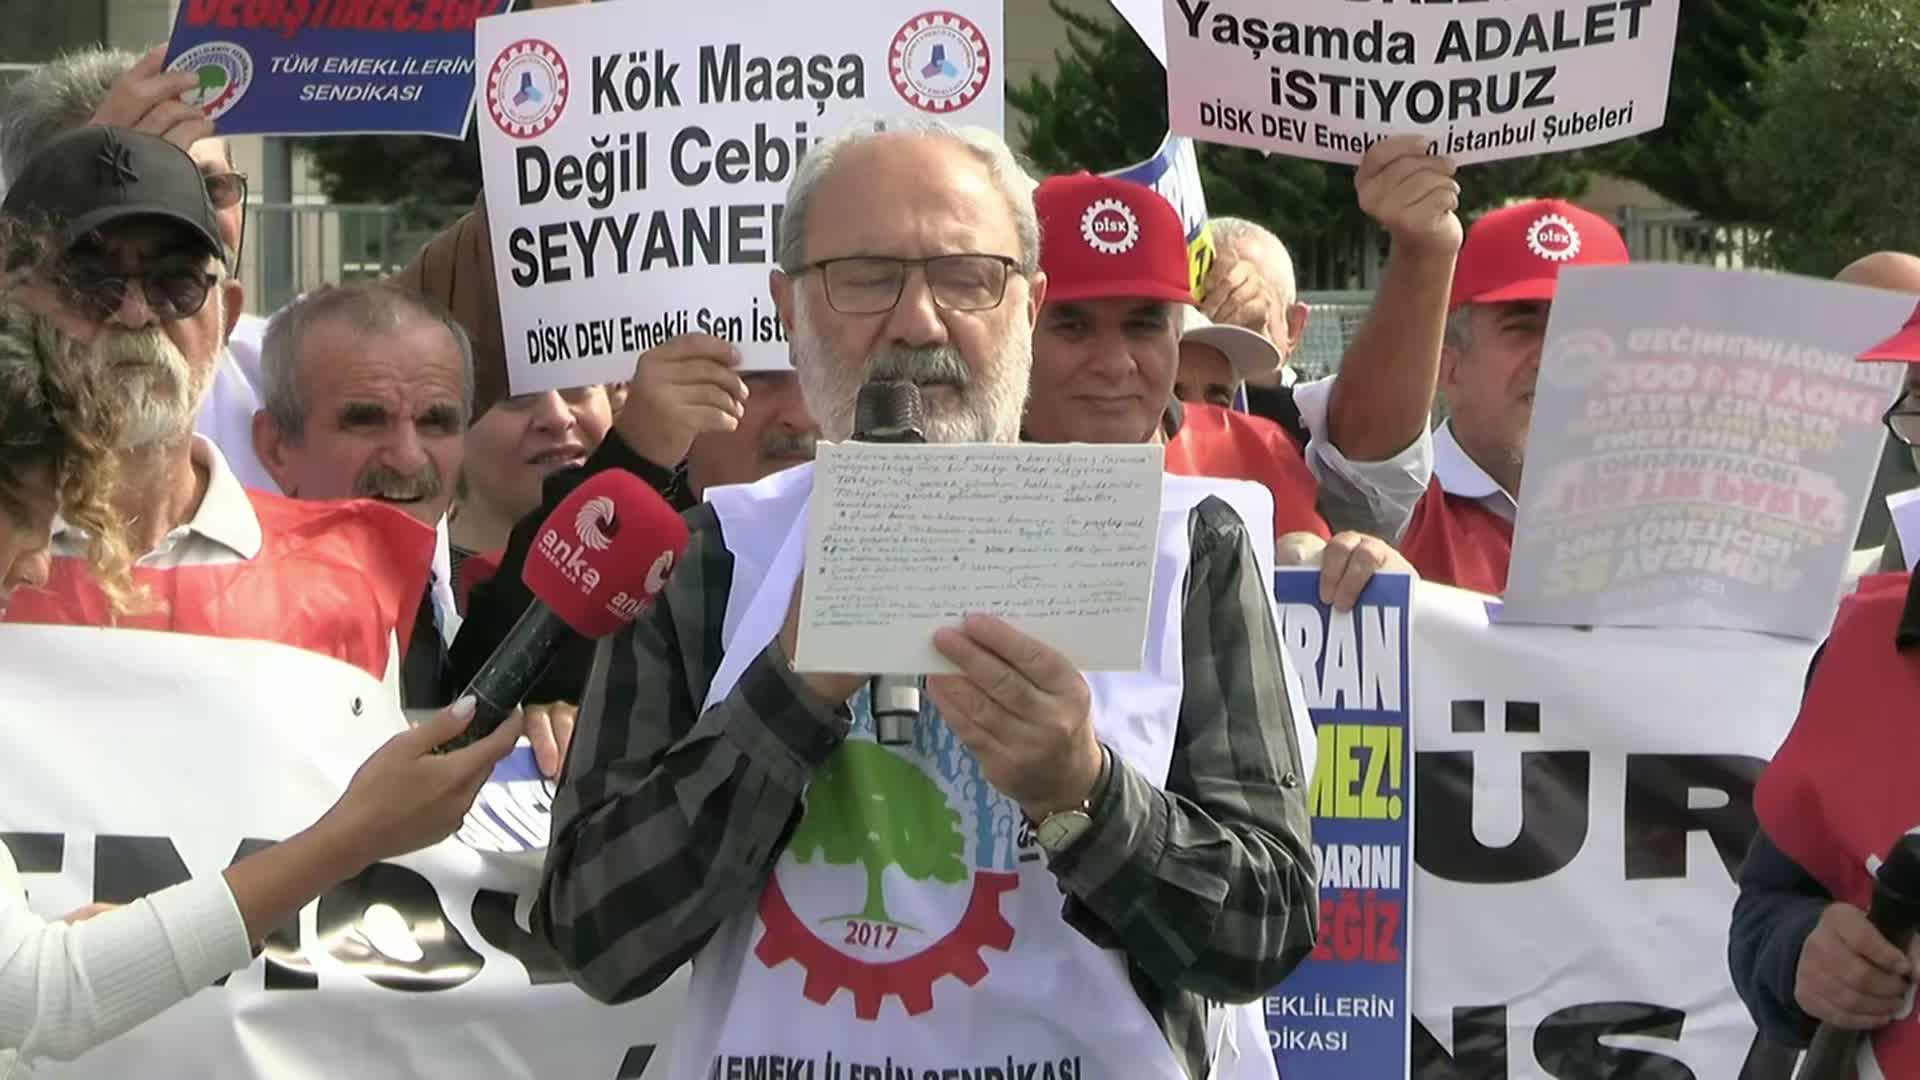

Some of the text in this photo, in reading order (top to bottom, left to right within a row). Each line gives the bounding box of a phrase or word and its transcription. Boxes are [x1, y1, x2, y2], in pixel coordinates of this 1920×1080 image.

[1177, 0, 1653, 64] Yaşamda ADALET
[271, 54, 319, 74] TÜM
[322, 55, 475, 75] EMEKLİLERİN
[299, 83, 424, 102] SENDİKASI
[591, 49, 681, 115] Kök
[699, 43, 866, 116] Maaşa
[1200, 101, 1252, 133] DİSK
[1262, 113, 1308, 145] DEV
[1314, 123, 1388, 154] Emek
[1542, 100, 1634, 141] Şubeleri
[515, 121, 826, 208] Değil Cebi
[510, 203, 785, 289] SEYYANE
[527, 318, 571, 365] DİSK
[575, 318, 614, 358] DEV
[620, 309, 689, 353] Emekli
[752, 297, 789, 343] İst
[542, 529, 600, 589] anka
[1276, 602, 1402, 712] RAN
[844, 920, 898, 950] 2017
[1266, 993, 1394, 1018] EKLİLERİN
[1411, 1000, 1800, 1080] NS
